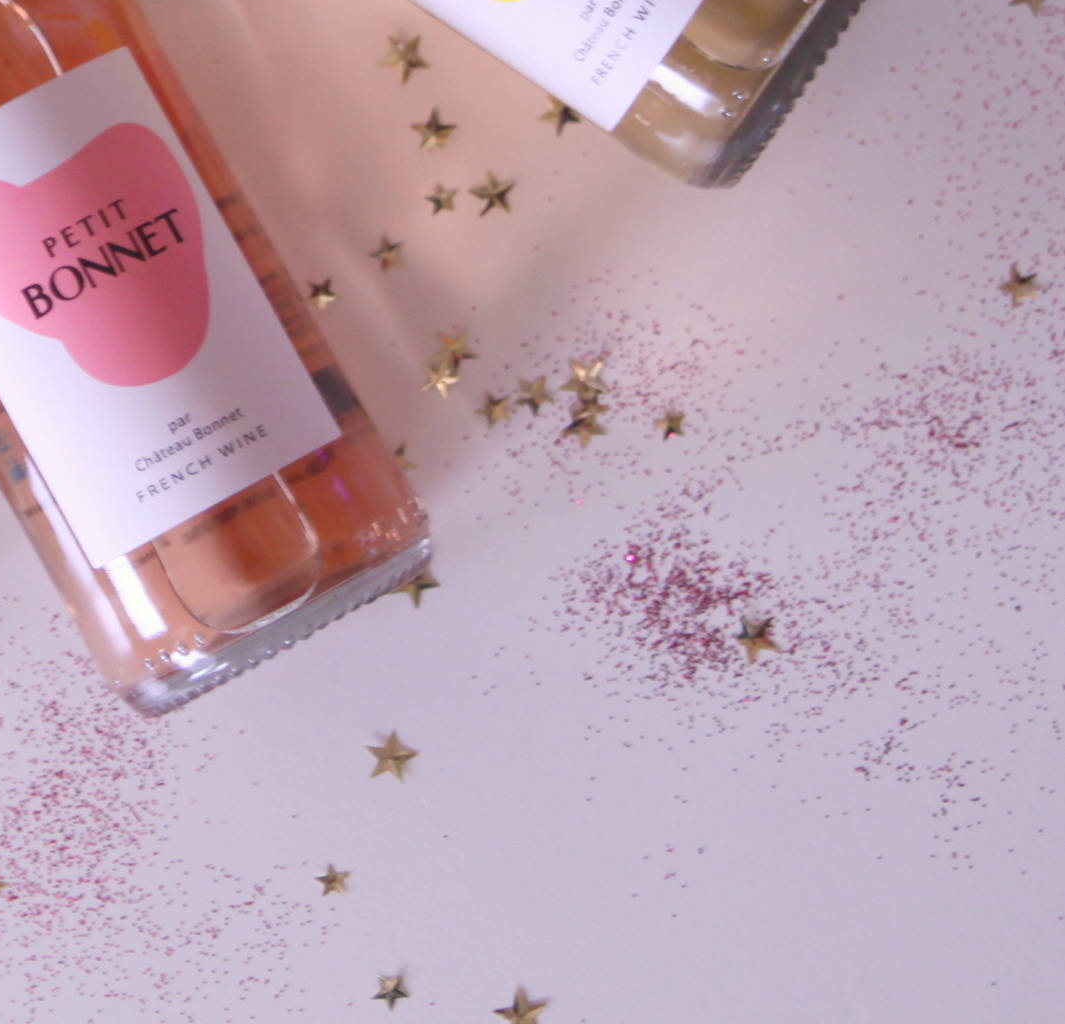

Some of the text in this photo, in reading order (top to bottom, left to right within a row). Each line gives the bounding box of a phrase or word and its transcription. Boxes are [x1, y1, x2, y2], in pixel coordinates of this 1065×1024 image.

[580, 0, 597, 22] par
[590, 26, 636, 86] FRENCH
[42, 198, 126, 258] PETIT
[21, 208, 184, 320] BONNET
[134, 408, 245, 473] Château Bonnet
[167, 413, 191, 435] par
[136, 424, 268, 504] FRENCH WINE
